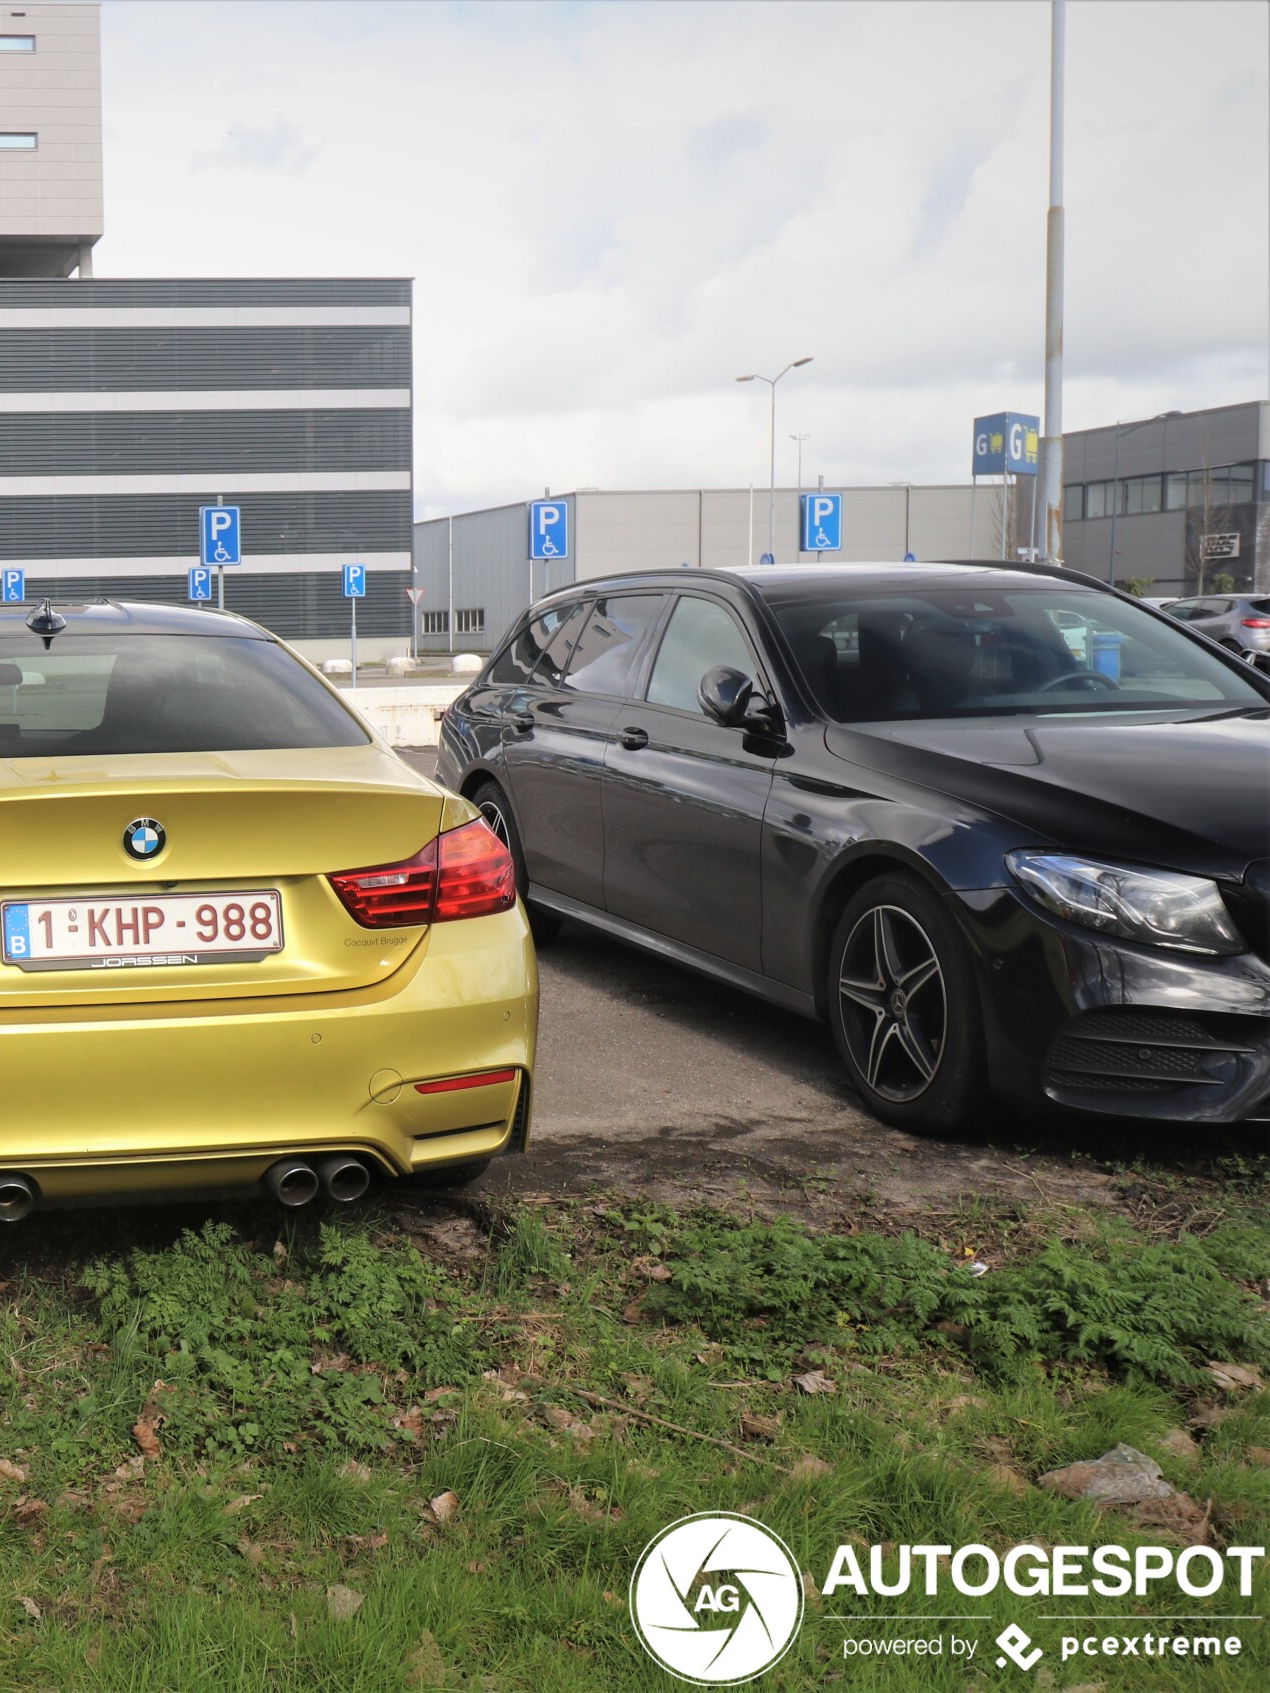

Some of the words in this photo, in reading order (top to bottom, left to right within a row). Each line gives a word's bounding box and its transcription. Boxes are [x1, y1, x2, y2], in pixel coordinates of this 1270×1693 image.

[976, 433, 987, 456] G
[1010, 423, 1022, 461] G
[815, 498, 833, 525] P
[212, 512, 231, 540] P
[540, 507, 559, 534] P
[8, 571, 20, 588] P
[195, 570, 206, 586] P
[349, 568, 360, 583] P
[127, 819, 164, 834] BMW
[11, 936, 26, 954] B
[380, 936, 408, 946] Brugge
[91, 954, 198, 968] JORSSEN
